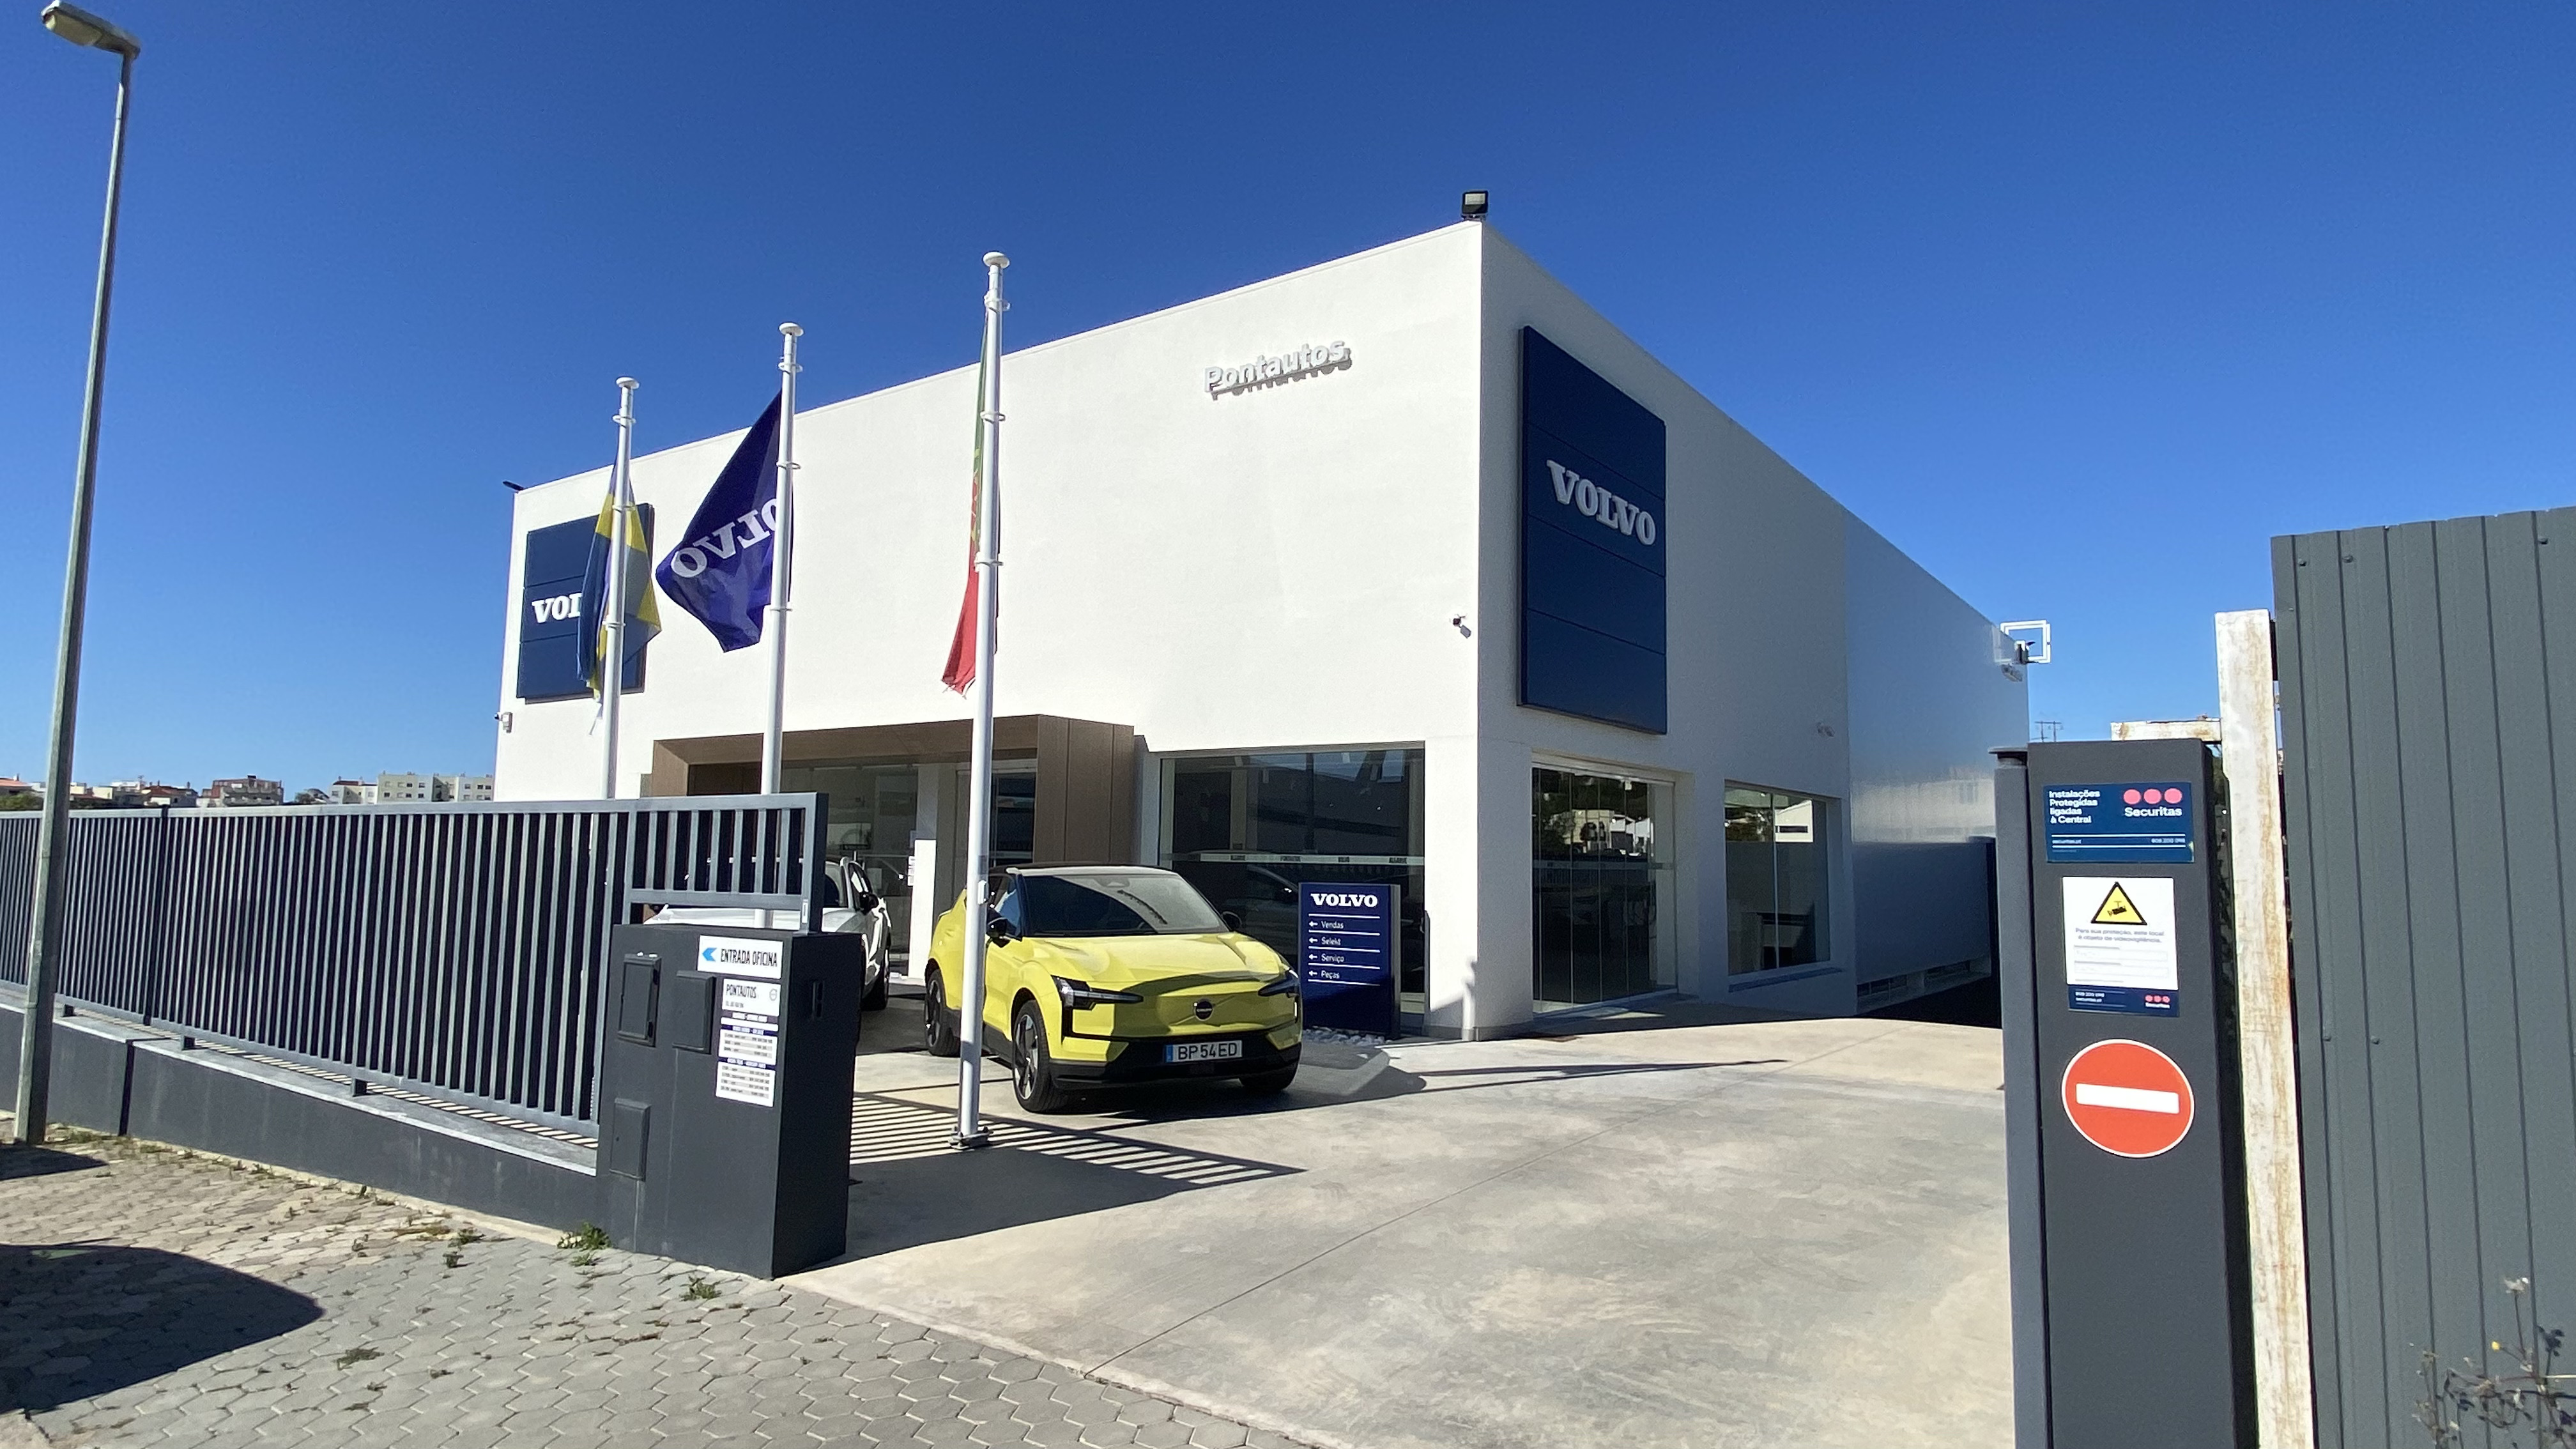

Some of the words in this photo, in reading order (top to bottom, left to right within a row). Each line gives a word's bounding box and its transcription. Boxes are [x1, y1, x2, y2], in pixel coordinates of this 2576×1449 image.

[1204, 341, 1347, 392] Pontautos
[1546, 459, 1656, 545] VOLVO
[532, 592, 583, 623] VOL
[2049, 790, 2100, 801] Instalações
[2050, 799, 2098, 808] Protegidas
[2124, 806, 2182, 816] Securitas
[2058, 815, 2092, 824] Central
[1310, 893, 1378, 907] VOLVO
[1321, 921, 1344, 929] Vendas
[1321, 937, 1341, 946] Selekt
[721, 948, 750, 964] ENTRADA
[752, 951, 778, 967] OFICINA
[1321, 954, 1345, 963] Serviço
[1321, 970, 1340, 979] Peças
[726, 983, 756, 999] PONTAUTOS
